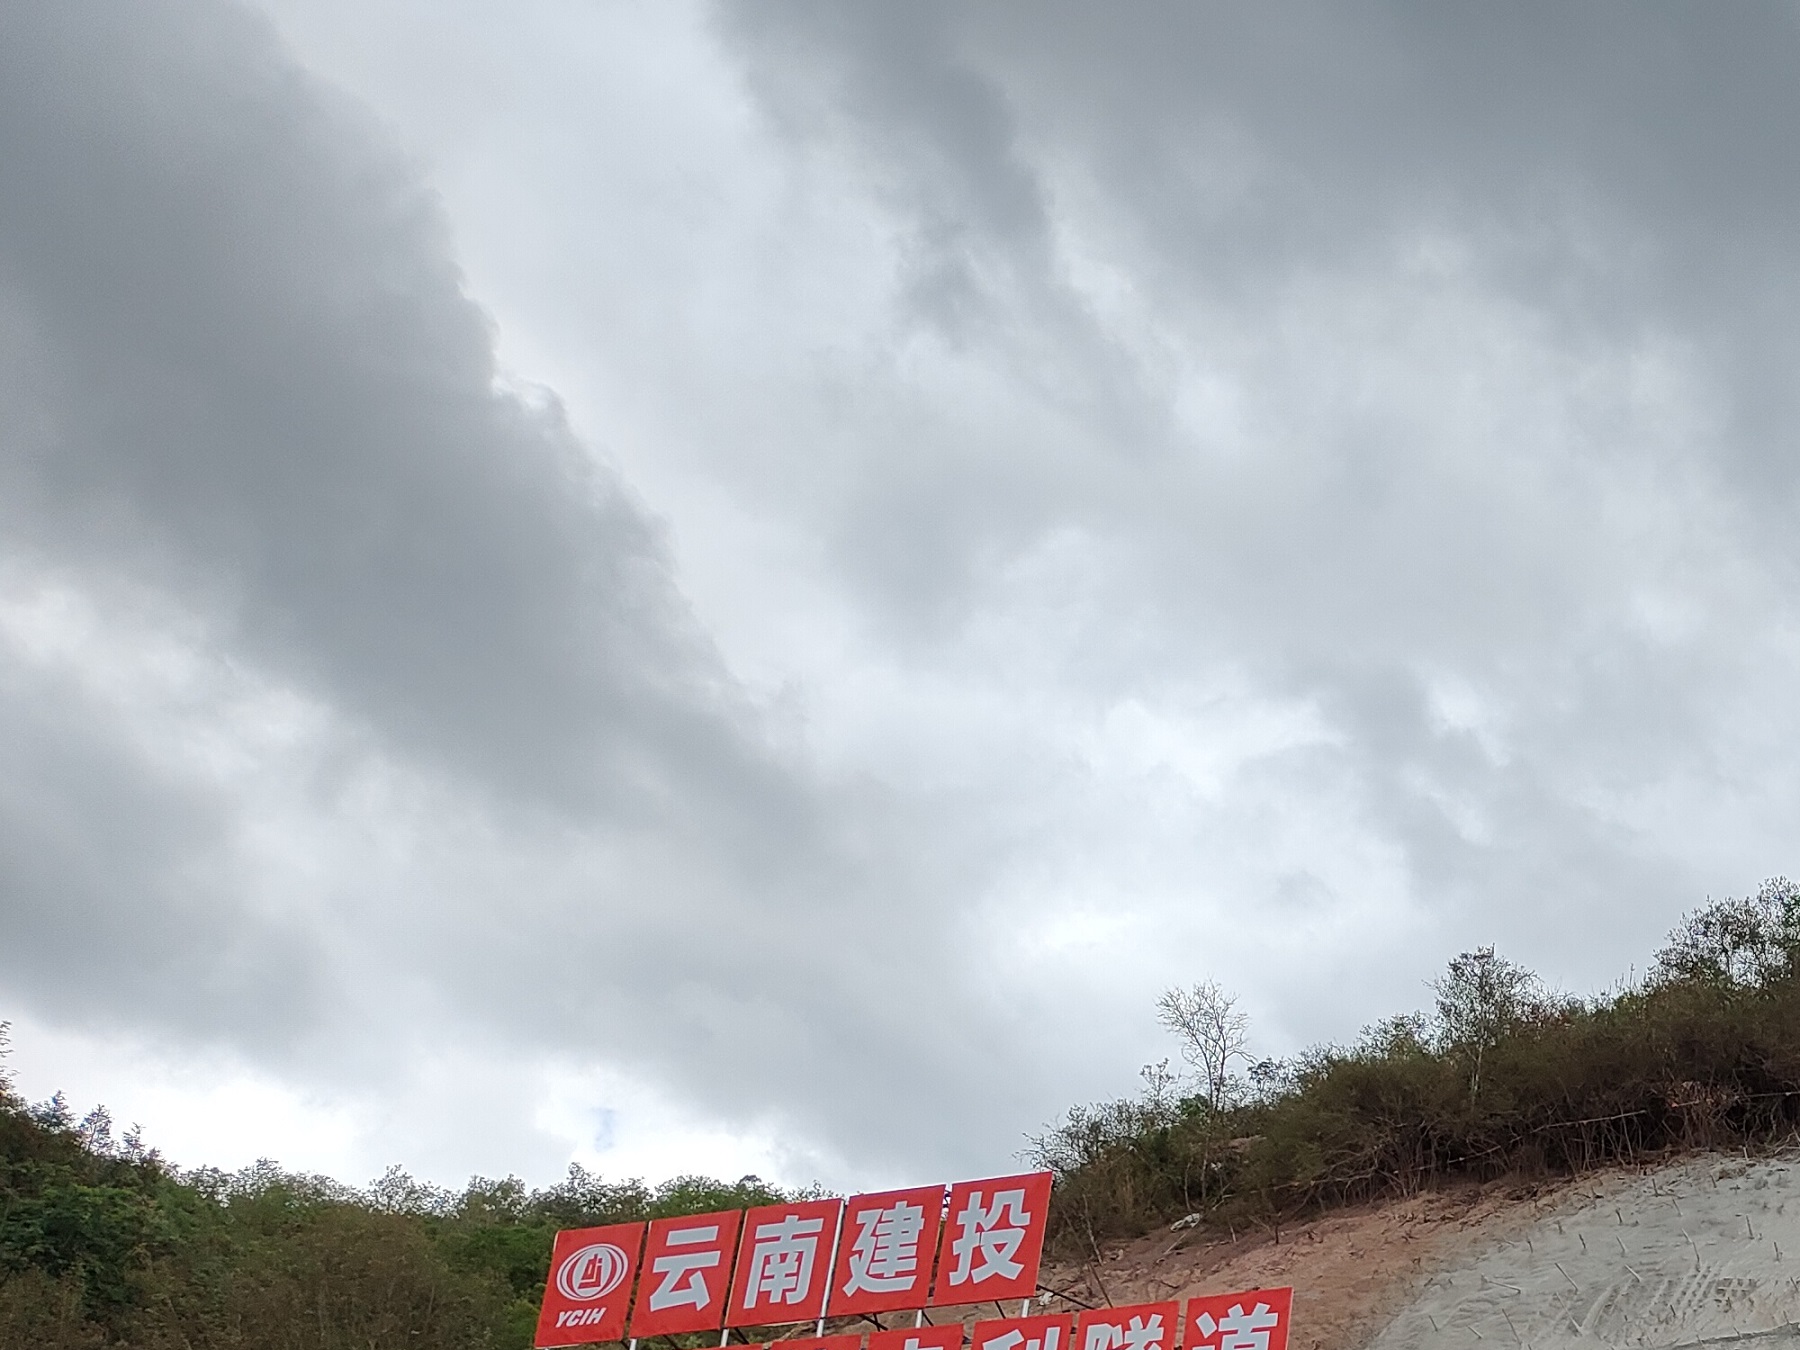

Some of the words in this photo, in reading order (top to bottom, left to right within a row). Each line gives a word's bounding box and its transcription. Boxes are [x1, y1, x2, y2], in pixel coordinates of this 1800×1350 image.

[650, 1188, 1032, 1312] 云南建投
[555, 1307, 607, 1329] YCIH
